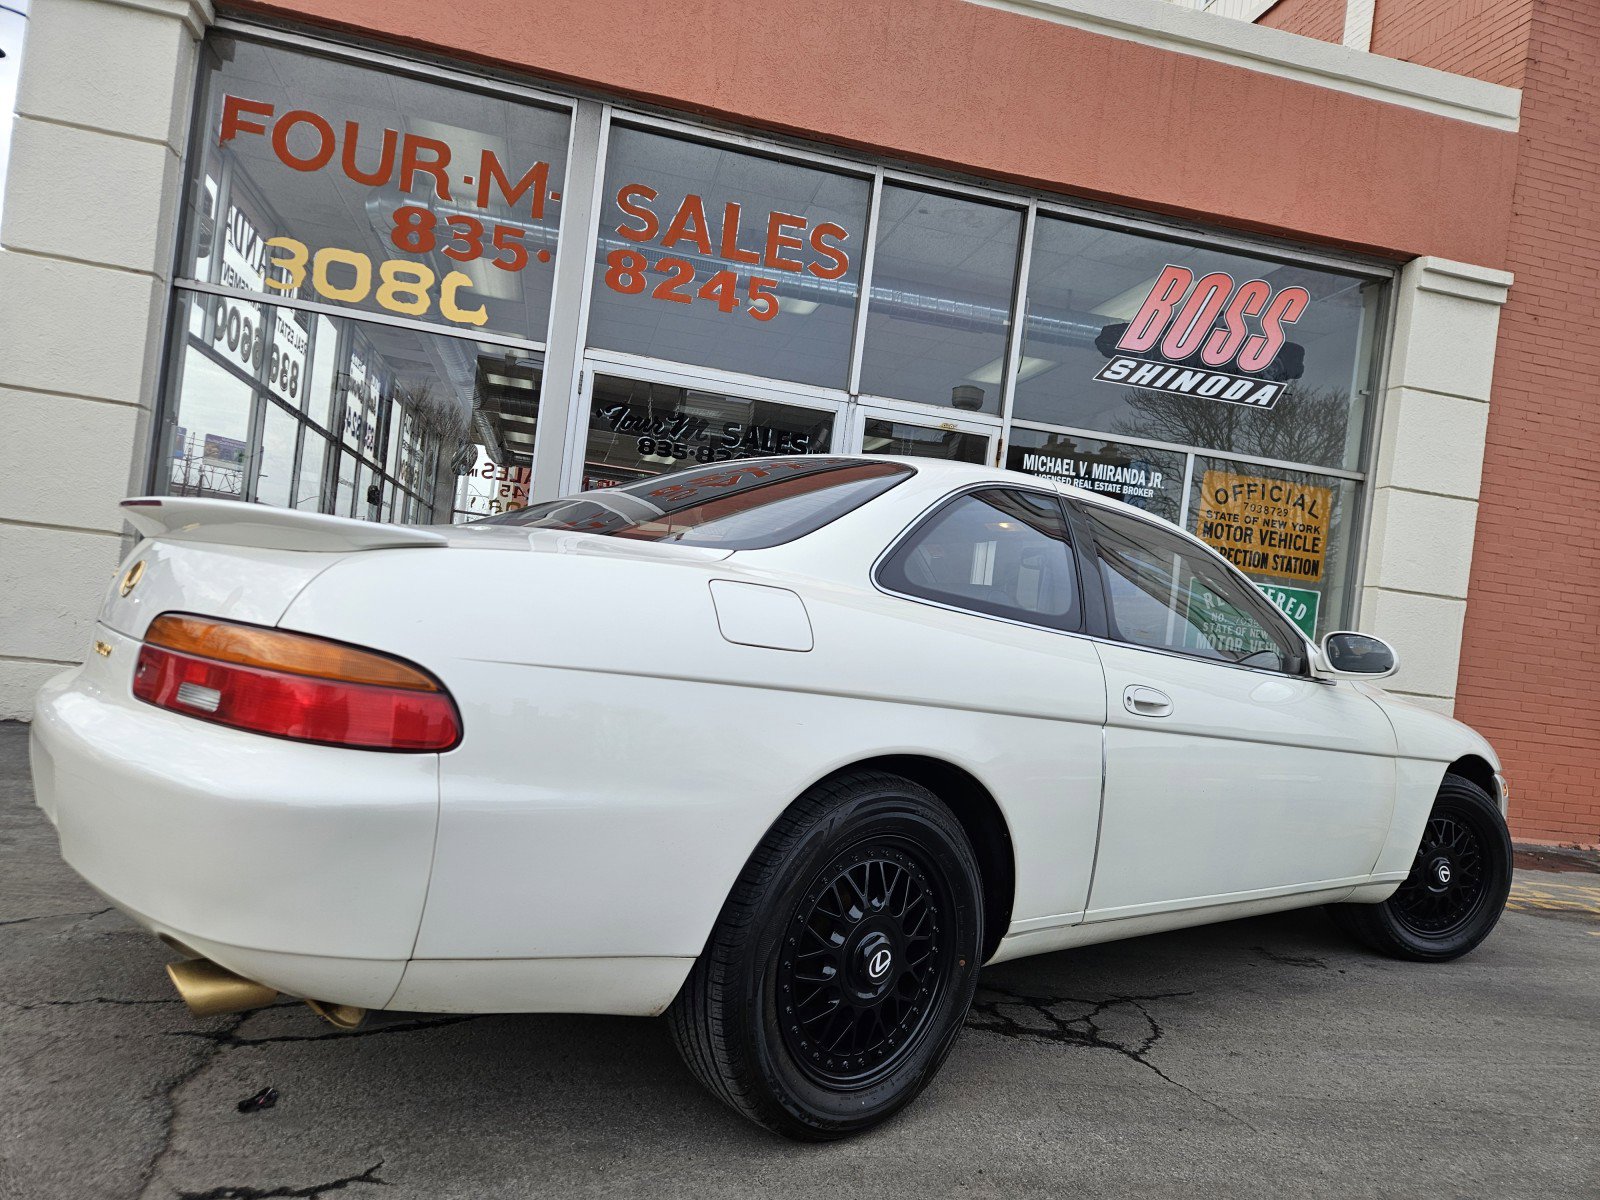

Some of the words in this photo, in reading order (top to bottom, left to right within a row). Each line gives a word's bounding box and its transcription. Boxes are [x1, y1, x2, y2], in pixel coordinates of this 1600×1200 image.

[615, 183, 850, 280] SALES
[265, 236, 489, 327] 308C
[604, 249, 781, 322] 8245
[1115, 264, 1311, 374] BOSS
[1102, 360, 1279, 406] SHINODA
[720, 421, 811, 455] SALES
[1023, 454, 1077, 476] MICHAEL
[1079, 460, 1089, 478] V.
[1091, 463, 1146, 486] MIRANDA
[1148, 471, 1165, 489] JR.
[1073, 478, 1093, 489] REAL
[1094, 481, 1121, 493] ESTATE
[1122, 485, 1154, 498] BROKER
[1214, 483, 1320, 520] OFFICIAL
[1242, 502, 1289, 518] 7038729
[1202, 520, 1254, 544] MOTOR
[1259, 528, 1322, 554] VEHICLE
[1206, 509, 1240, 523] STATE
[1244, 515, 1259, 526] OF
[1262, 518, 1288, 530] NEW
[1291, 522, 1321, 535] YORK
[1213, 545, 1269, 570] PECTION
[1272, 553, 1320, 577] STATION
[1202, 622, 1233, 635] STATE
[1249, 628, 1269, 641] NEW
